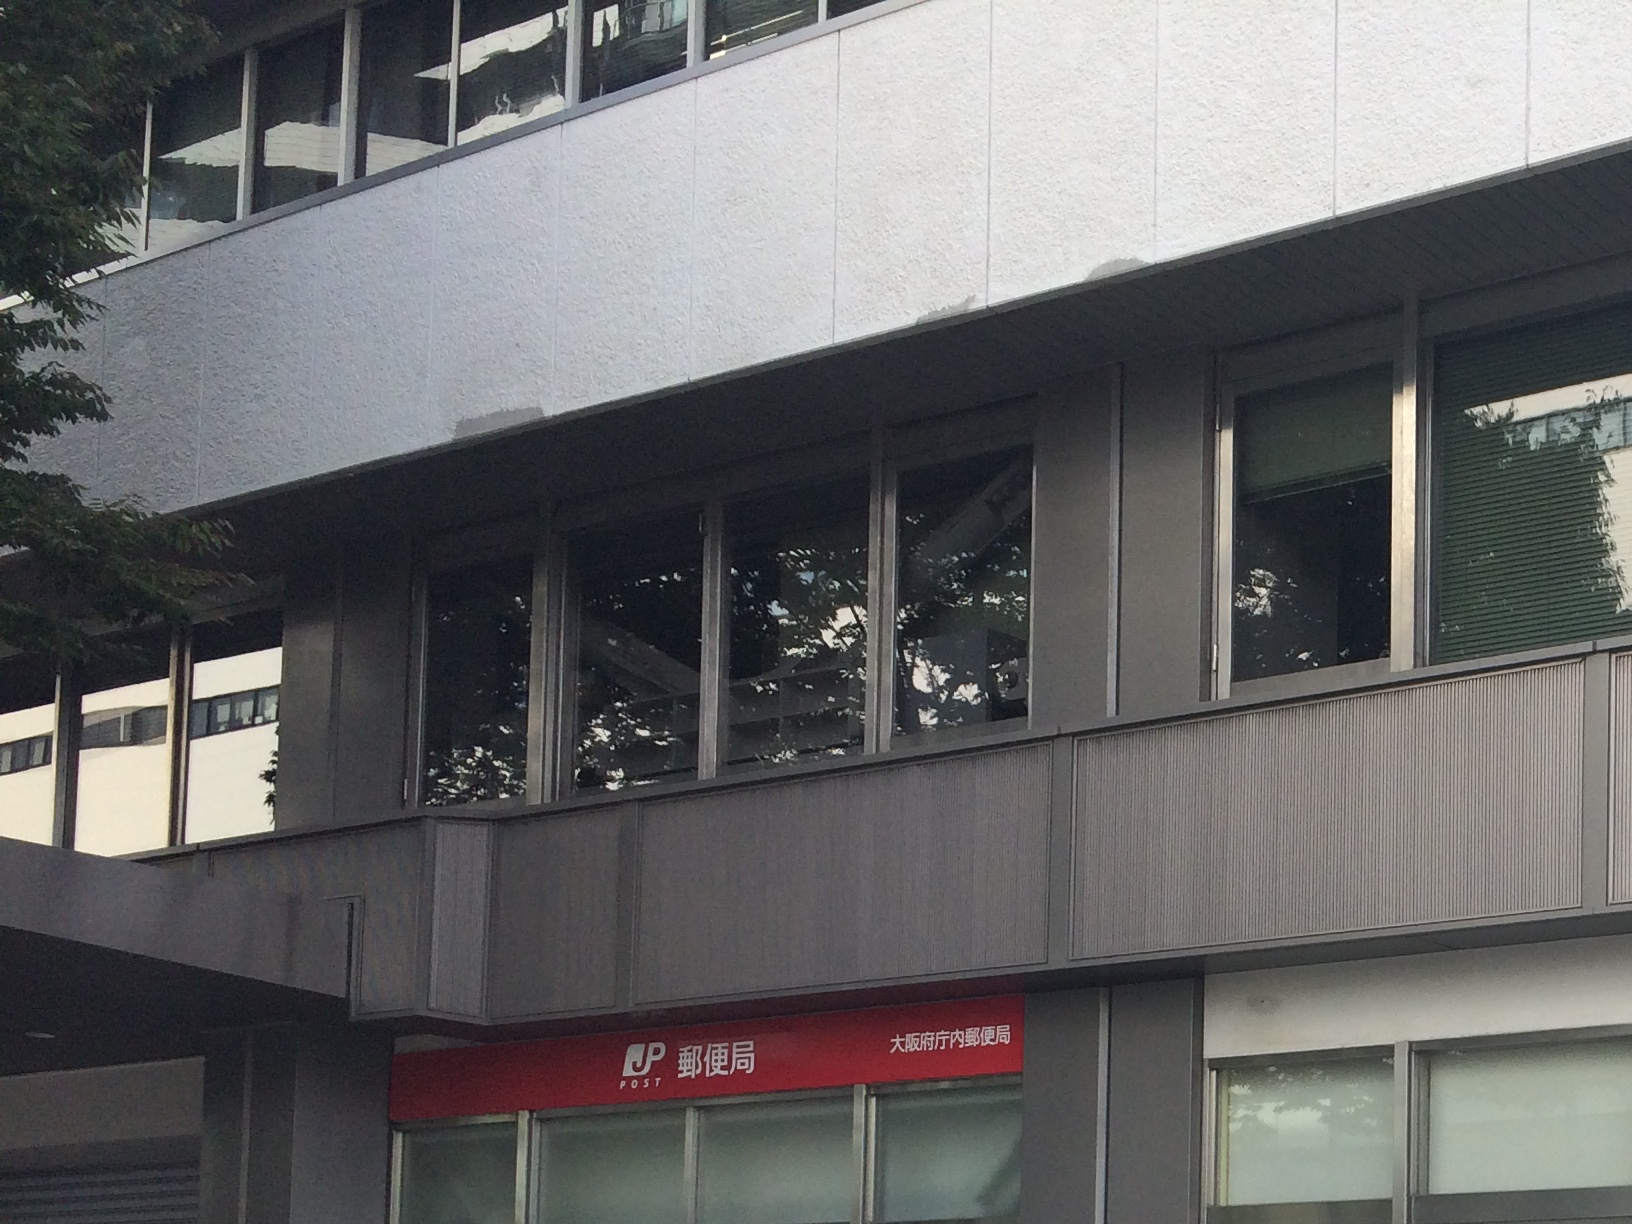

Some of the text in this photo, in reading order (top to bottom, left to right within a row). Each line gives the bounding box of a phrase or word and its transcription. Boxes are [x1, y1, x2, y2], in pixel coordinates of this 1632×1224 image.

[889, 1024, 1011, 1054] 大阪府庁内郵便局
[622, 1040, 755, 1079] JP 郵便局
[619, 1077, 662, 1090] POST
